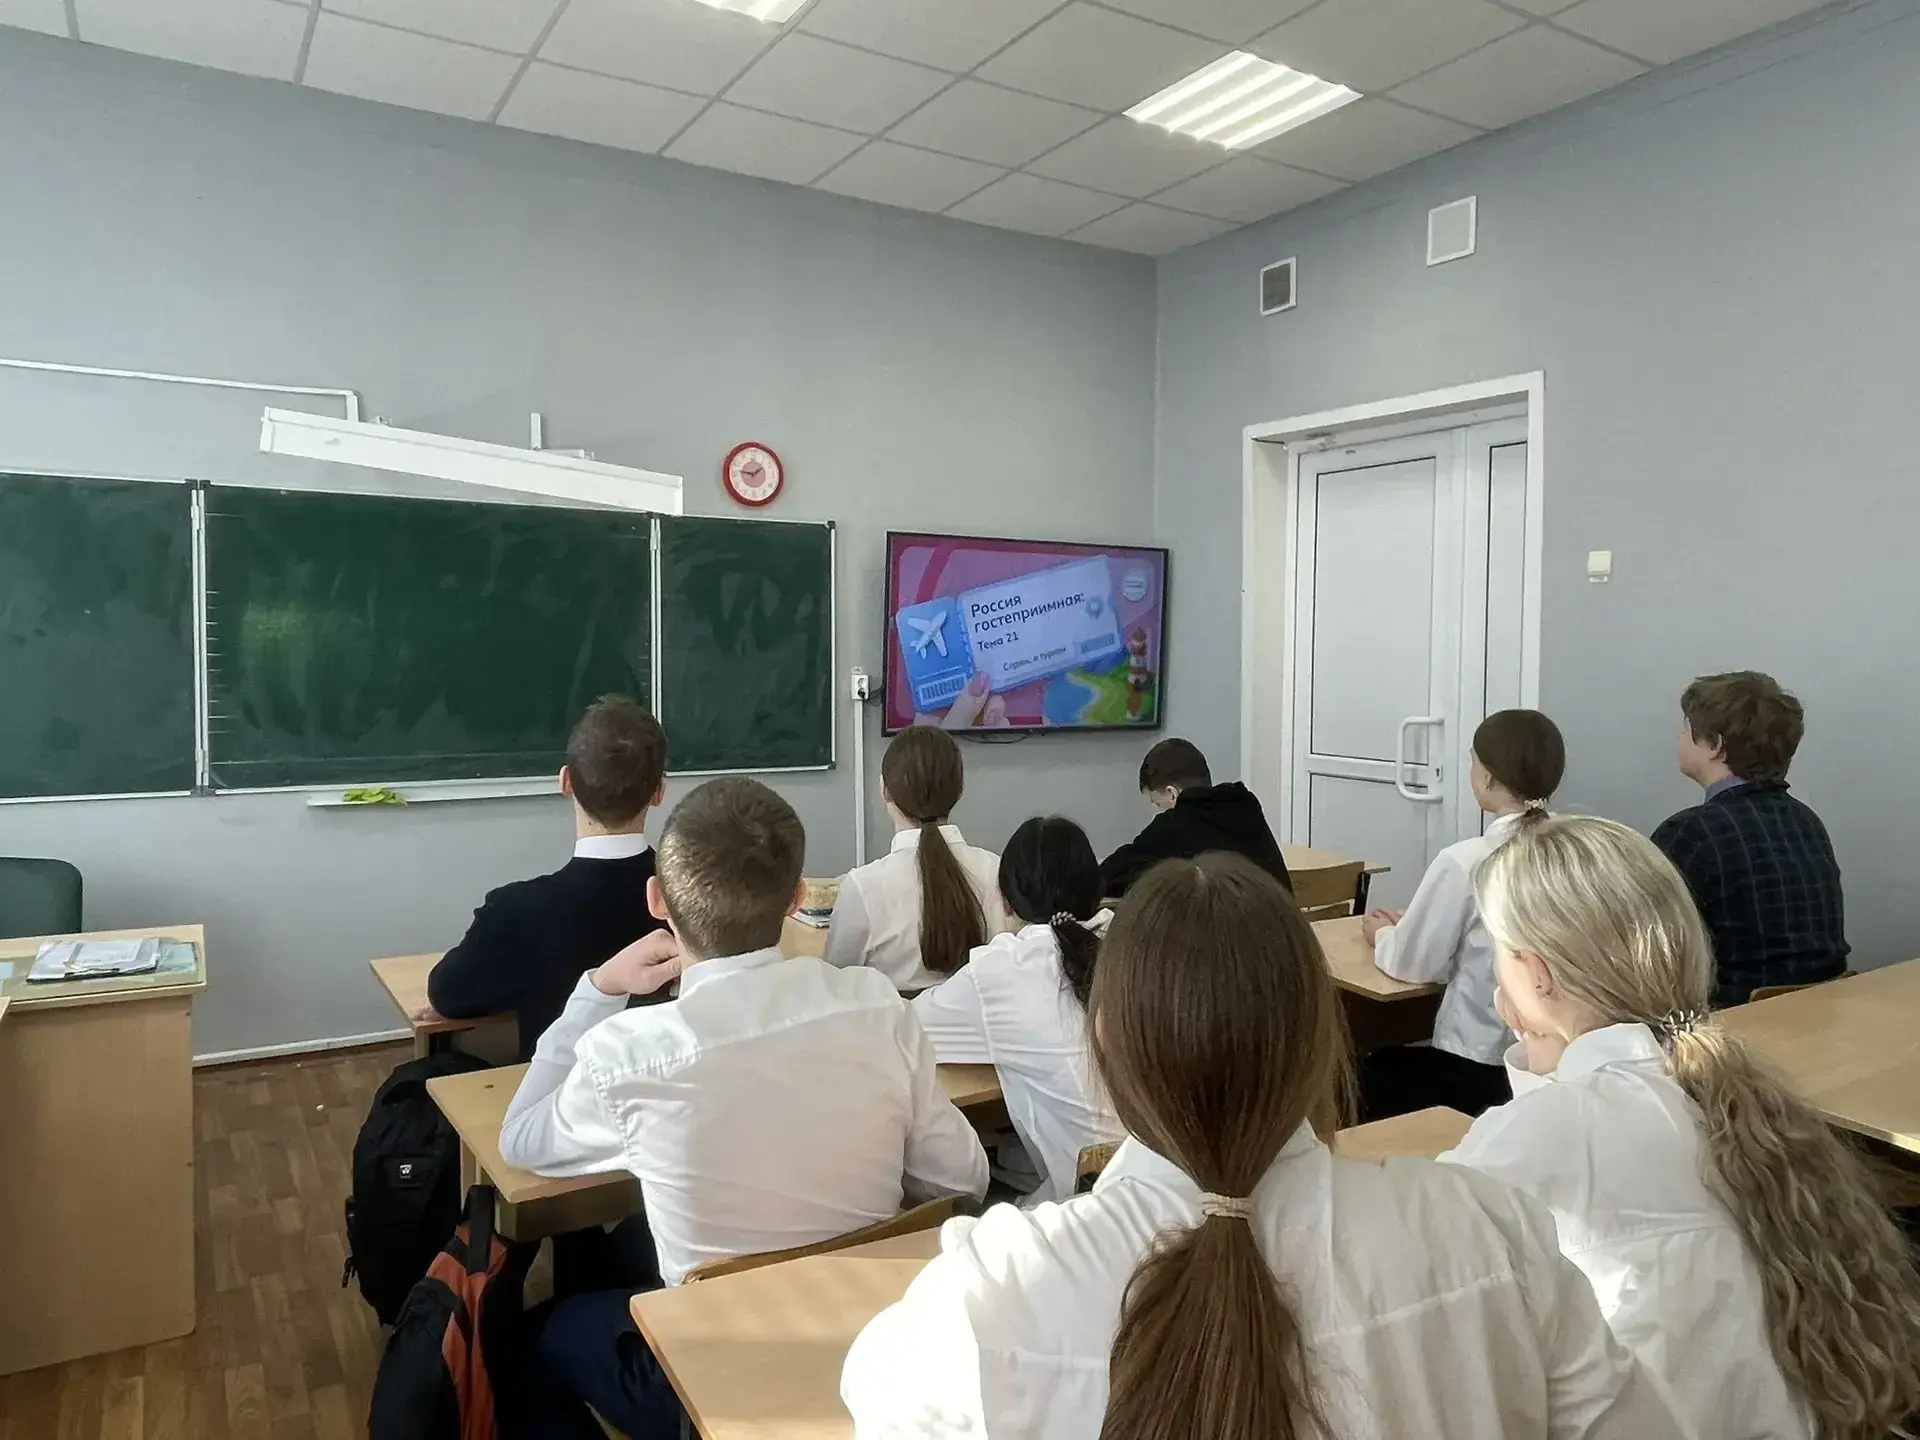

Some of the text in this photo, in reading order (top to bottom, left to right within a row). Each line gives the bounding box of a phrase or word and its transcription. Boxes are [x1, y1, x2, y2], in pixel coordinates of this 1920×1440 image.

[971, 595, 1022, 618] Россия
[974, 592, 1086, 633] гостеприимная:
[977, 631, 1019, 652] Тема 21
